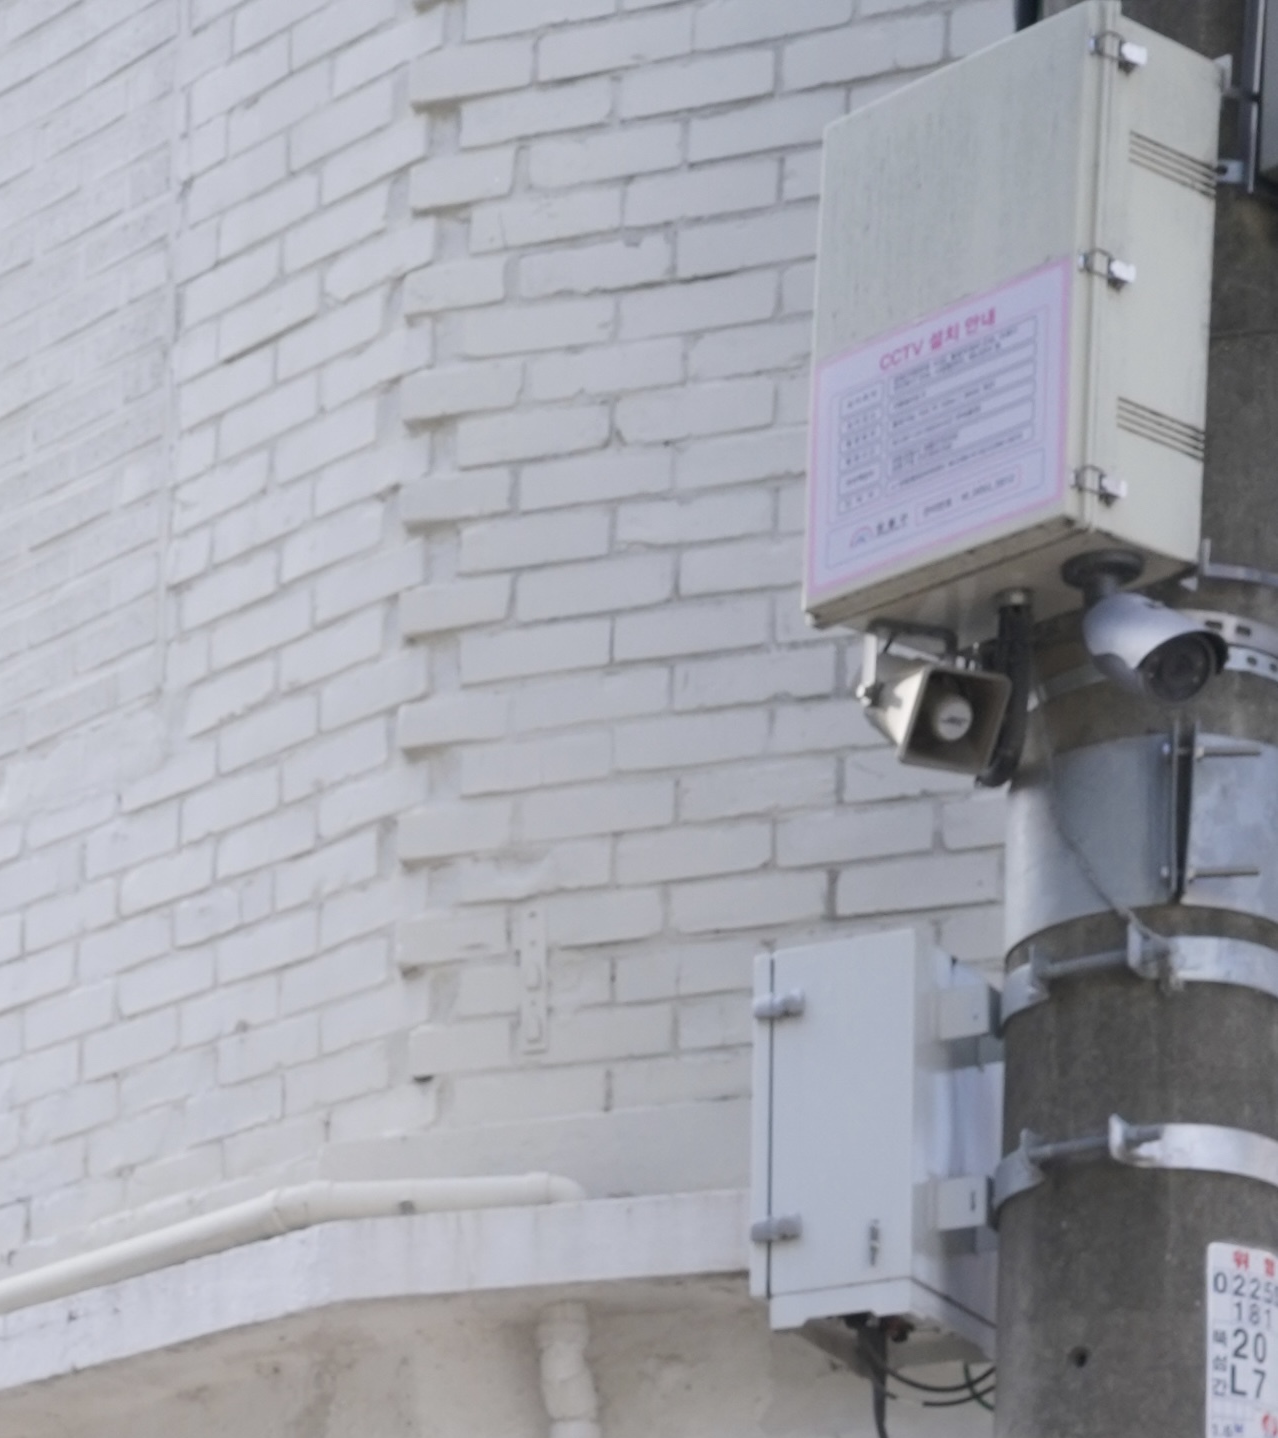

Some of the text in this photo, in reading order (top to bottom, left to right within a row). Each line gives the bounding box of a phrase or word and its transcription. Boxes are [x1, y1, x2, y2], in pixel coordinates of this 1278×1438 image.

[879, 339, 925, 370] CCTV
[965, 306, 996, 335] 안내
[1234, 1301, 1272, 1329] 181
[1232, 1327, 1268, 1364] 20
[1229, 1363, 1267, 1399] L7
